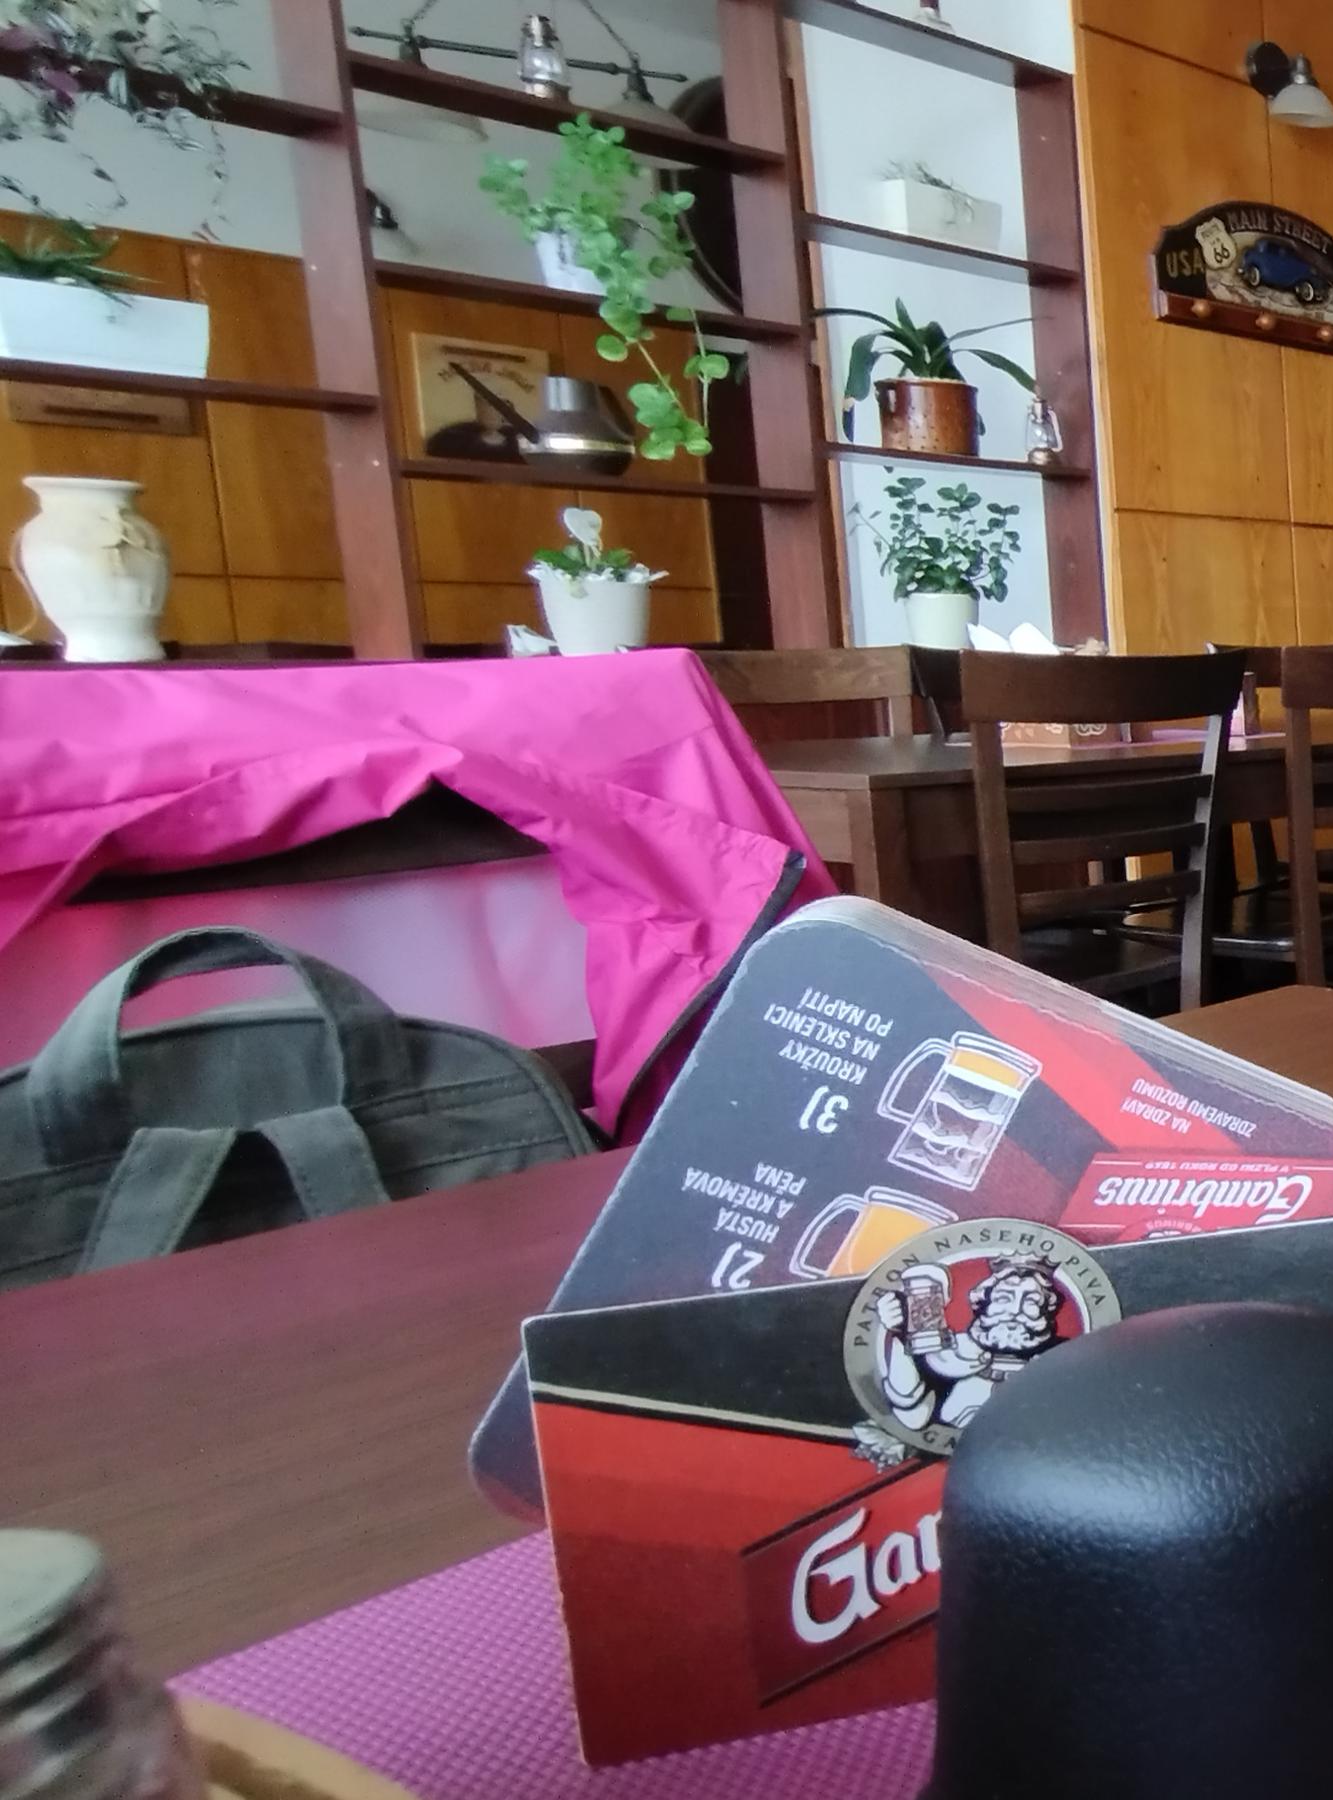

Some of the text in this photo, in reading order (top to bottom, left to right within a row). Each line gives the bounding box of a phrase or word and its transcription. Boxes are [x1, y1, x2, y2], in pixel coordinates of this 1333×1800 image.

[1227, 210, 1269, 233] MAIN
[1273, 211, 1333, 254] STREET
[1165, 249, 1205, 279] USA
[763, 1003, 881, 1061] NA SKLENICI
[797, 987, 894, 1037] PO NAPITÍ
[778, 1039, 868, 1085] KROUŽKY
[799, 1085, 849, 1134] 3)
[1131, 1078, 1257, 1138] ZDRAVÉMU ROZUMU
[1168, 1117, 1192, 1134] NA
[681, 1166, 795, 1219] A KRÉMOVÁ
[754, 1161, 808, 1197] PĚNA
[1094, 1175, 1313, 1225] Gambrinus
[713, 1208, 780, 1243] HUSTÁ
[711, 1242, 765, 1291] 2)
[853, 1227, 1107, 1347] PATRON NAŠEHO PIVA
